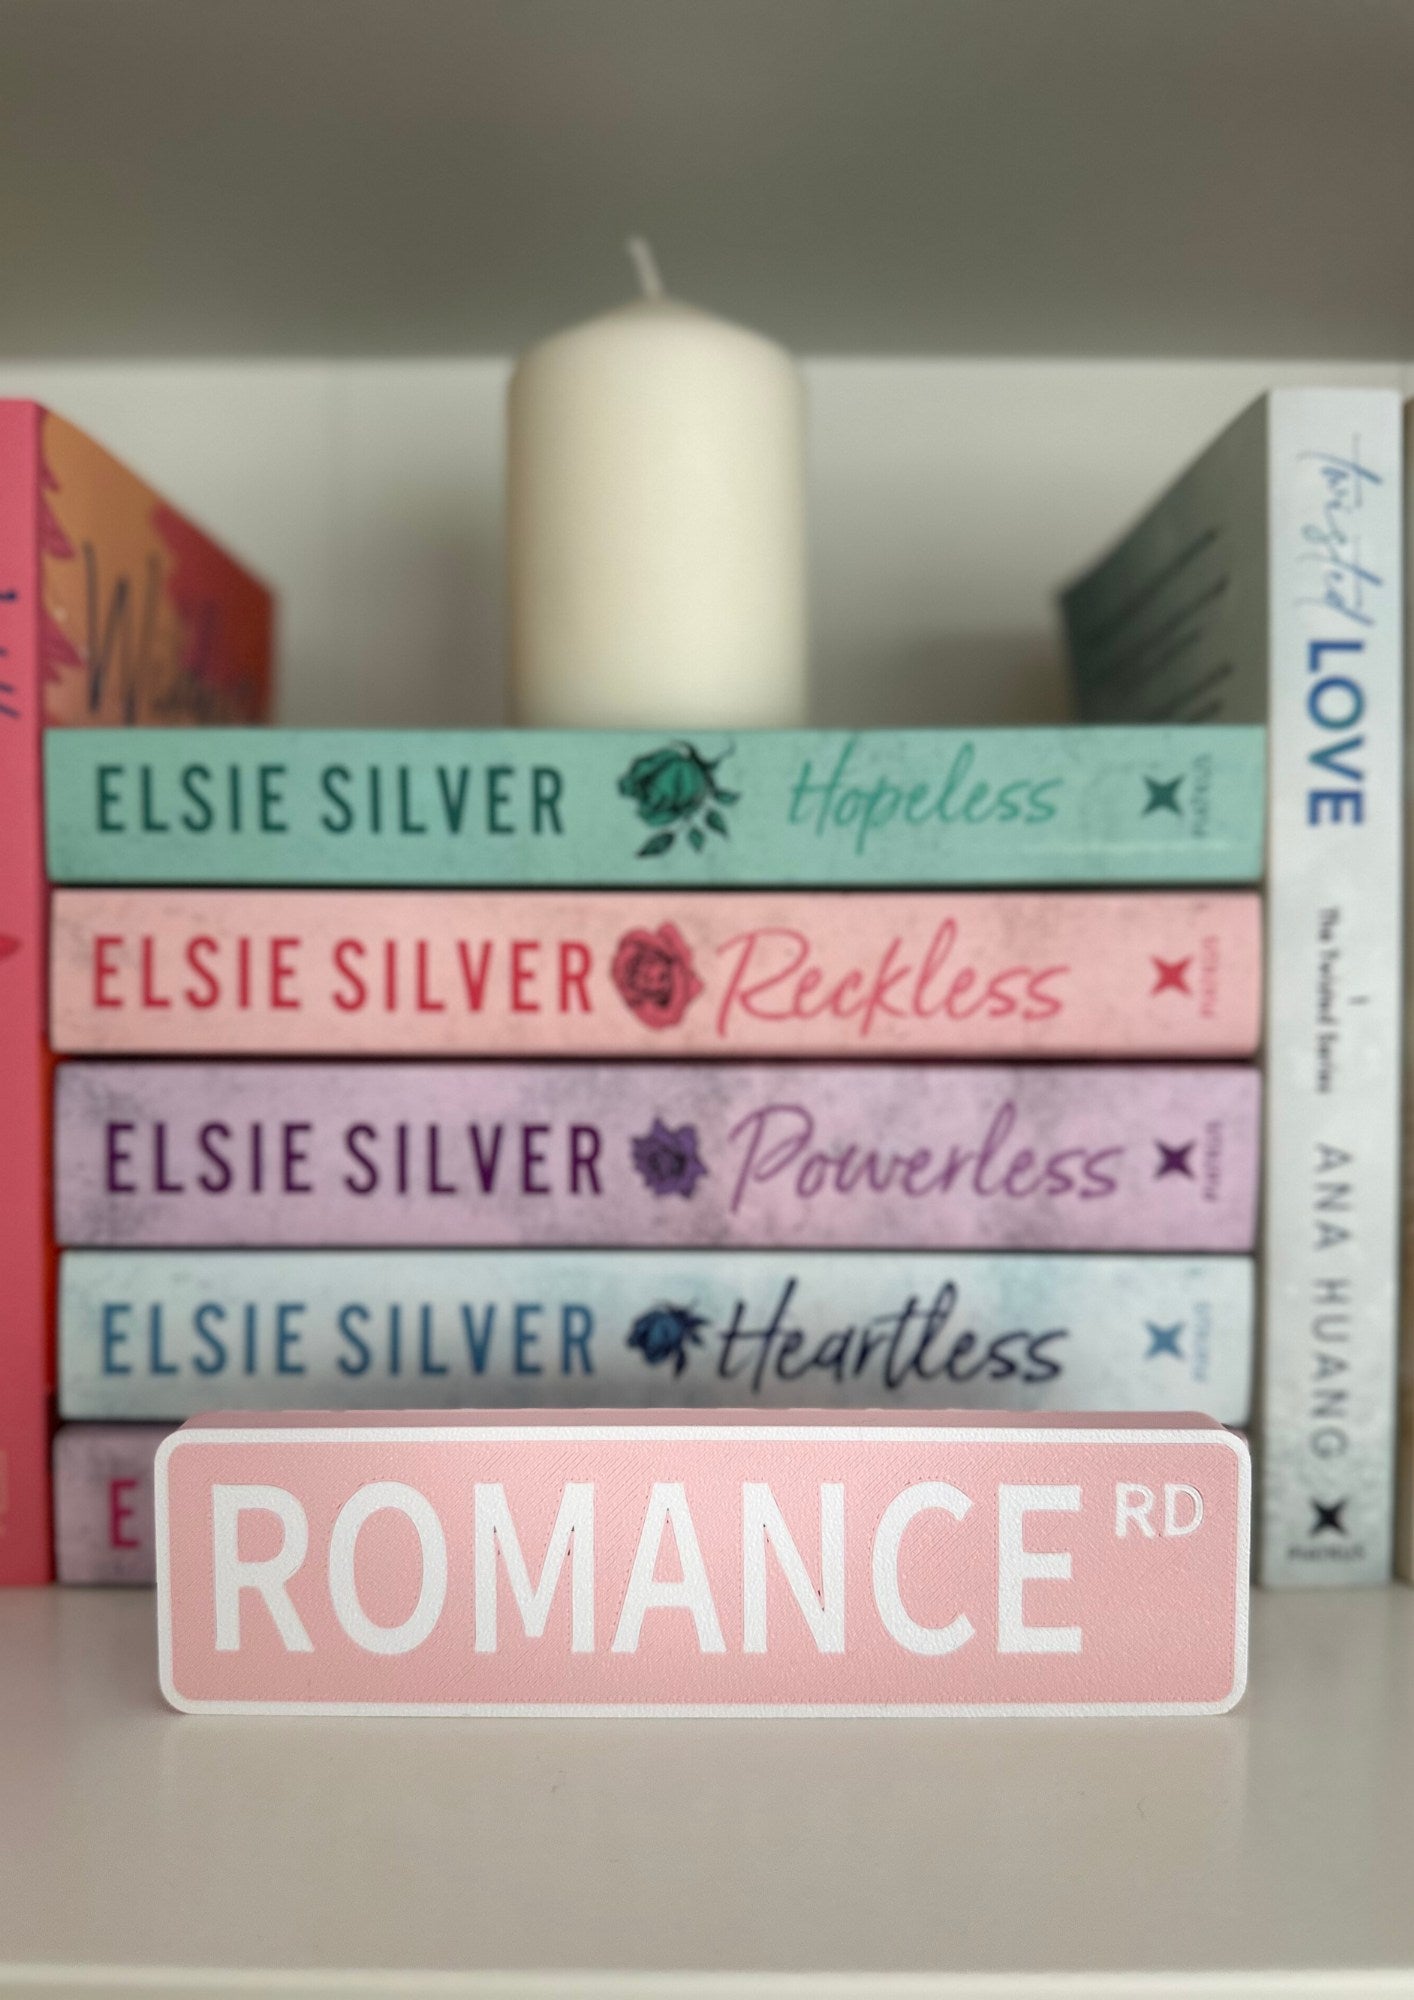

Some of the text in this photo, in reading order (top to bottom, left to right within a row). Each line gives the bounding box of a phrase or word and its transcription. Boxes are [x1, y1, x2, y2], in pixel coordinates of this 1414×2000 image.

[1307, 640, 1365, 827] LOVE
[96, 735, 1064, 856] ELSIE SILVER Hopeless
[93, 917, 1071, 1039] ELSIE SILVER Reckless
[1318, 908, 1340, 943] The
[106, 1101, 1125, 1215] ELSIE SILVER Powerless
[102, 1276, 1070, 1395] ELSIE SILVER Heartless
[1309, 1142, 1353, 1460] ANA HUANG
[211, 1480, 1083, 1656] ROMANCE
[1114, 1481, 1205, 1538] RD
